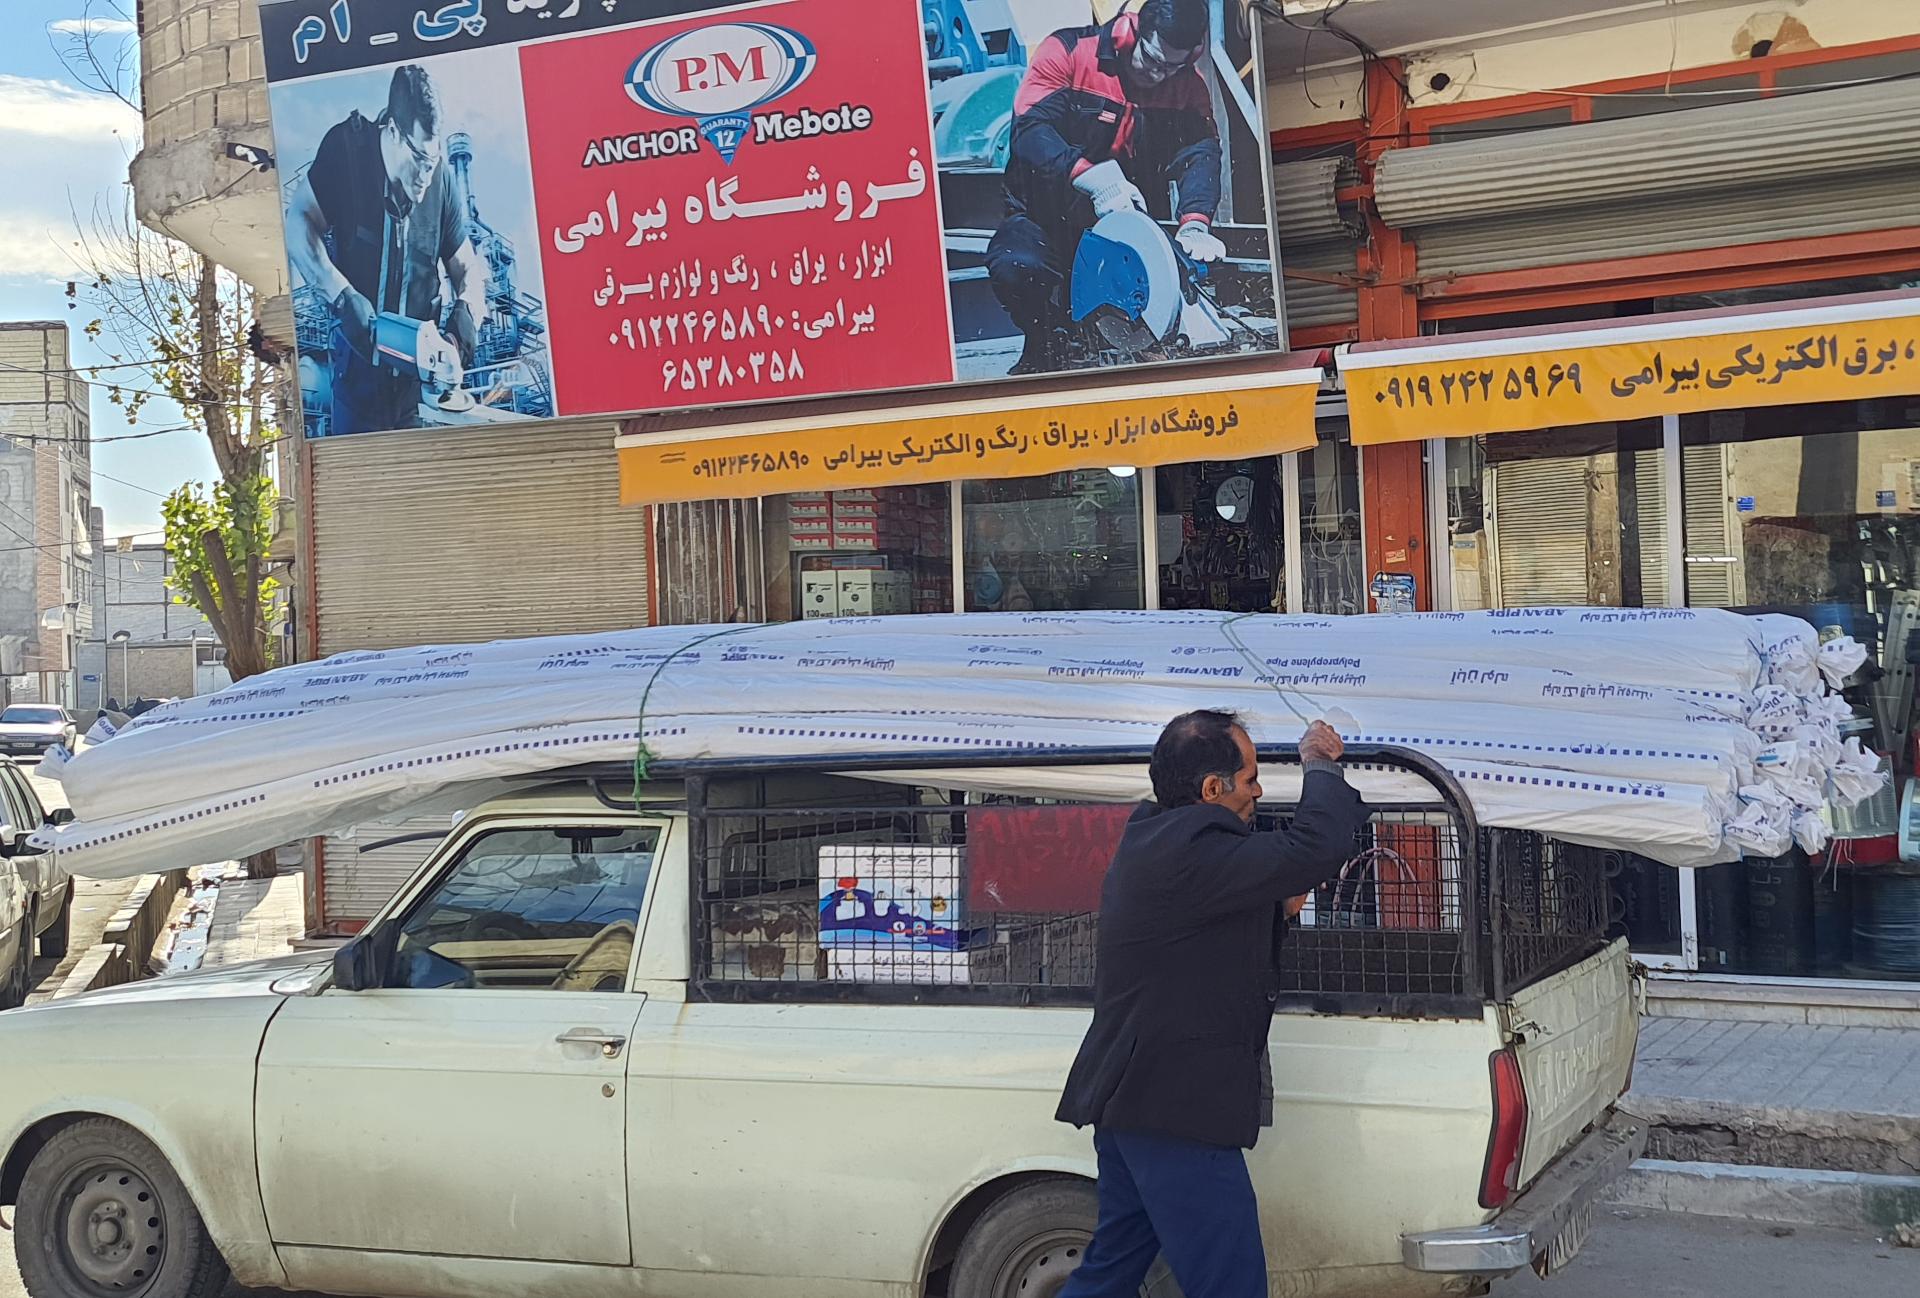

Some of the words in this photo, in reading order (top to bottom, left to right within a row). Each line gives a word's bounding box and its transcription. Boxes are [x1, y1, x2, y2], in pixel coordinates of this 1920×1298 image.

[672, 45, 769, 94] P.M
[699, 116, 751, 136] GUARANTY
[714, 130, 737, 149] 12
[753, 103, 873, 144] Mebote
[582, 127, 699, 167] ANCHOR
[684, 146, 928, 224] فروشگاه
[552, 189, 669, 255] بیرامی
[592, 266, 656, 308] برقی
[660, 258, 703, 302] لوازم
[709, 269, 720, 296] و
[723, 252, 761, 292] رنگ
[608, 302, 786, 351] ۰۹۱۲۲۴۶۵۸۹۰
[662, 346, 806, 394] ۶۵۳۸۰۳۵۸
[1610, 351, 1701, 398] بیرامی
[1705, 334, 1839, 389] الکتریکی
[1843, 337, 1898, 377] برق
[1150, 404, 1240, 438] فروشگاه
[886, 432, 972, 467] الکتریکی
[976, 436, 985, 459] و
[987, 423, 1029, 455] رنگ
[823, 443, 884, 471] بیرامی
[1165, 665, 1199, 675] PIPE
[1199, 665, 1243, 677] ABAN
[1265, 656, 1289, 667] Pipe
[1290, 656, 1361, 669] Polypropylene
[1449, 667, 1479, 686] آبان
[1480, 669, 1509, 685] لوله
[1541, 682, 1561, 697] لوله
[1562, 686, 1579, 698] تک
